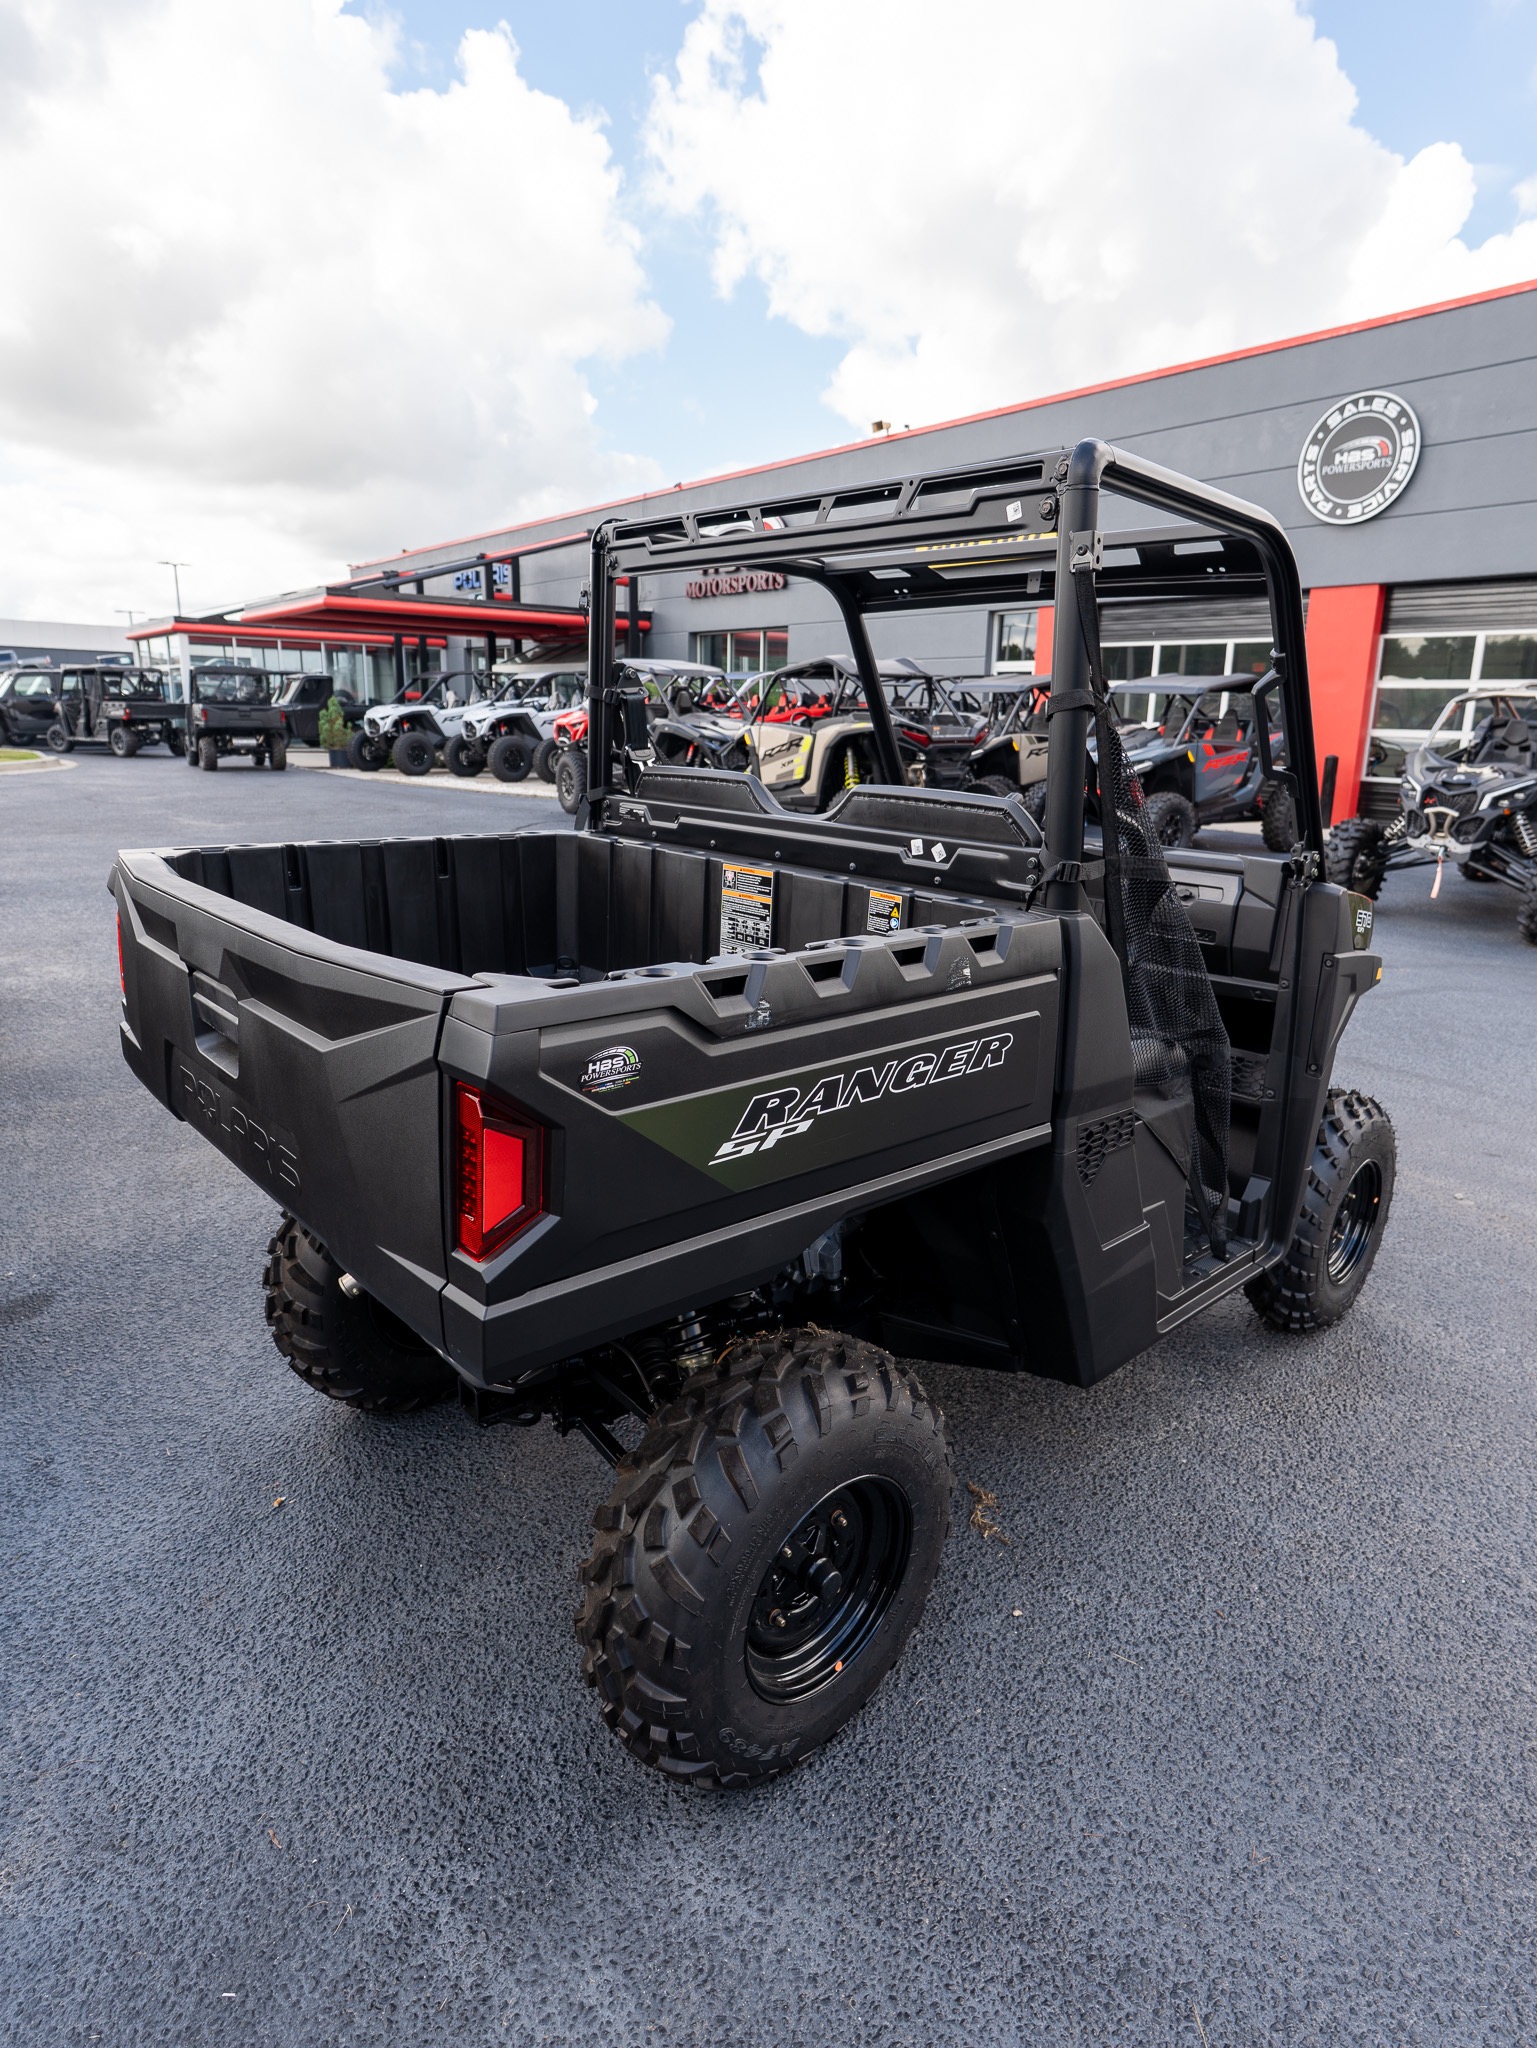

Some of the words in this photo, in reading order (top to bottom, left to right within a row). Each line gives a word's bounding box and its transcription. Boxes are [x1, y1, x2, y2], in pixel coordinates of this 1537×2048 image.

[1327, 397, 1401, 429] SALES
[1322, 457, 1392, 476] POWERSPORTS
[1334, 448, 1376, 465] HBS
[1303, 444, 1334, 514] PARTS
[1347, 428, 1415, 518] SERVICE
[454, 564, 509, 591] POLRIS
[685, 572, 786, 599] MOTORSPORTS
[580, 1062, 641, 1083] POWERSPORTS
[588, 1056, 625, 1074] HBS
[731, 1032, 1013, 1139] RANGER
[708, 1118, 814, 1166] SP
